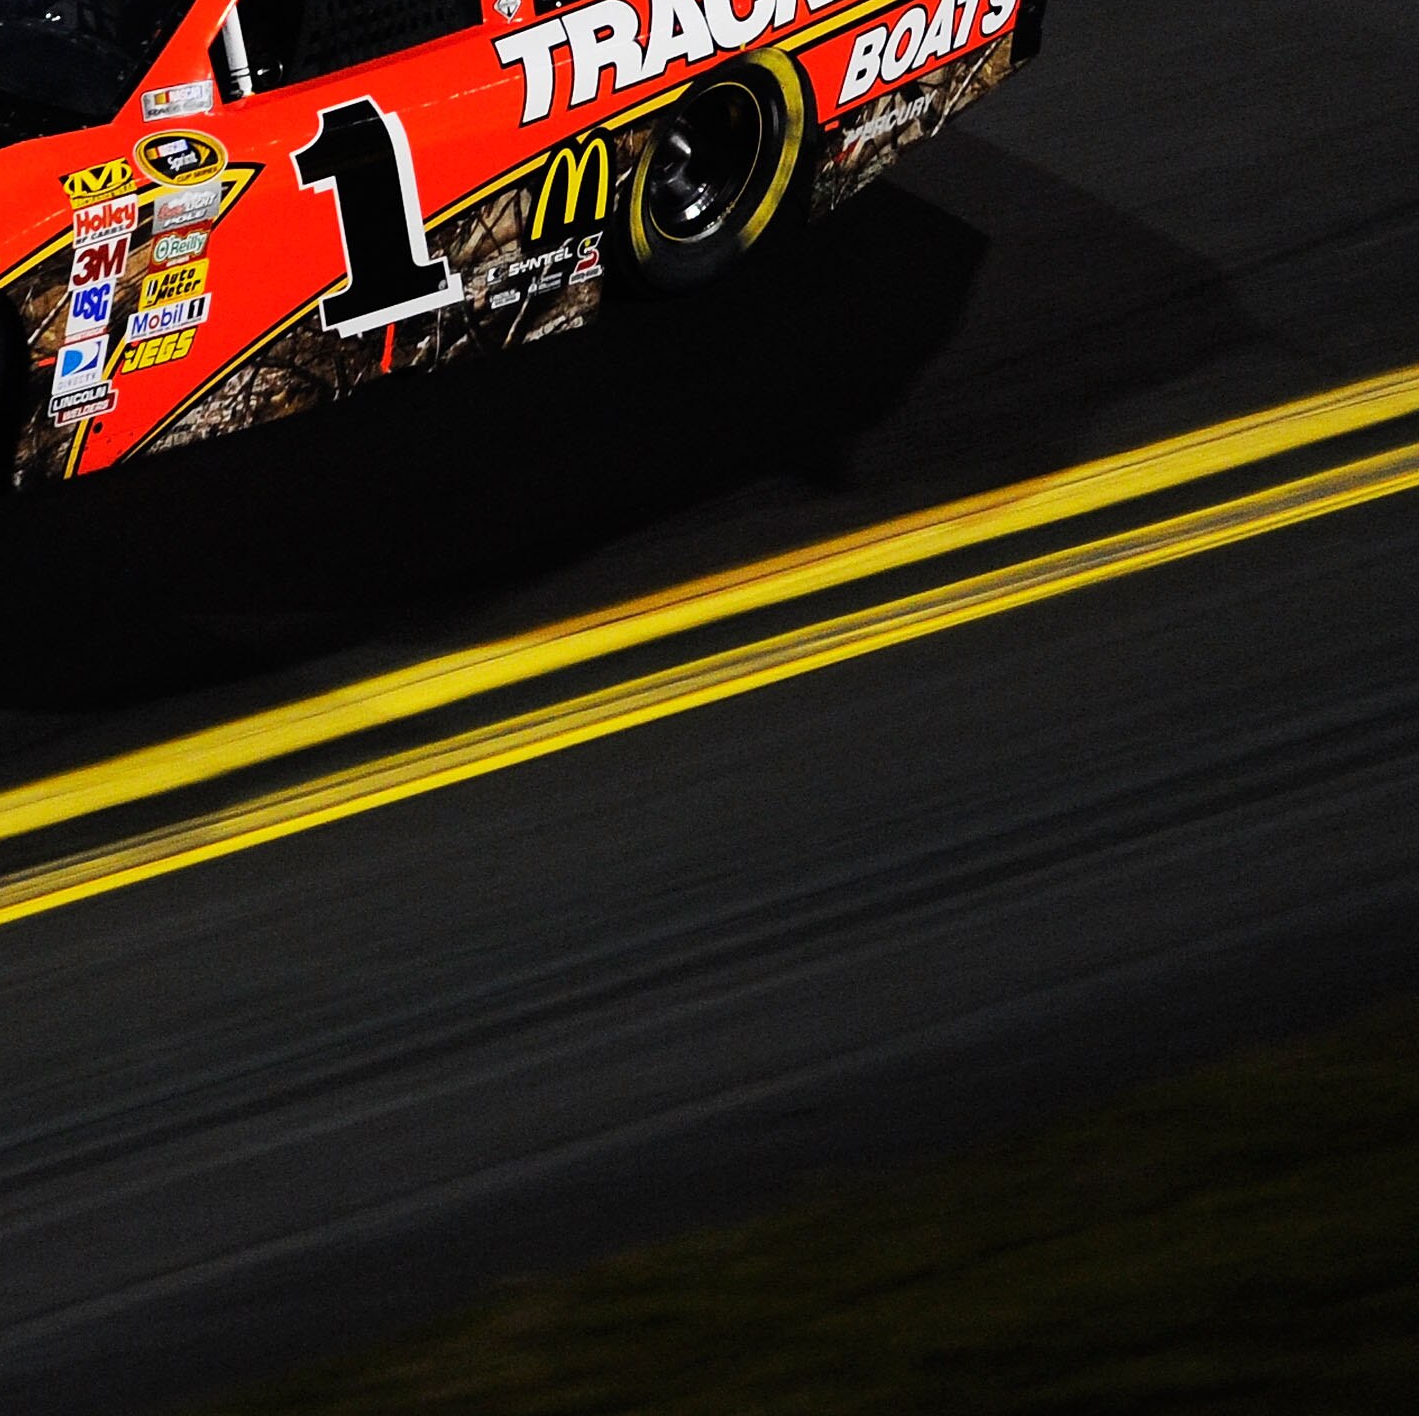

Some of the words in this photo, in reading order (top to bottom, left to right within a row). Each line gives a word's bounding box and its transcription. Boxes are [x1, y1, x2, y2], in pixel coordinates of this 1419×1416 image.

[166, 151, 198, 172] Sprint
[76, 201, 136, 237] Holley
[290, 94, 464, 339] 1
[73, 238, 128, 286] 3M
[162, 267, 196, 285] Auto
[73, 283, 111, 322] USG
[156, 279, 201, 300] Meter
[132, 303, 184, 336] Mobil
[188, 296, 205, 320] 1
[121, 327, 197, 374] JEGS
[53, 385, 107, 411] LINCOLN
